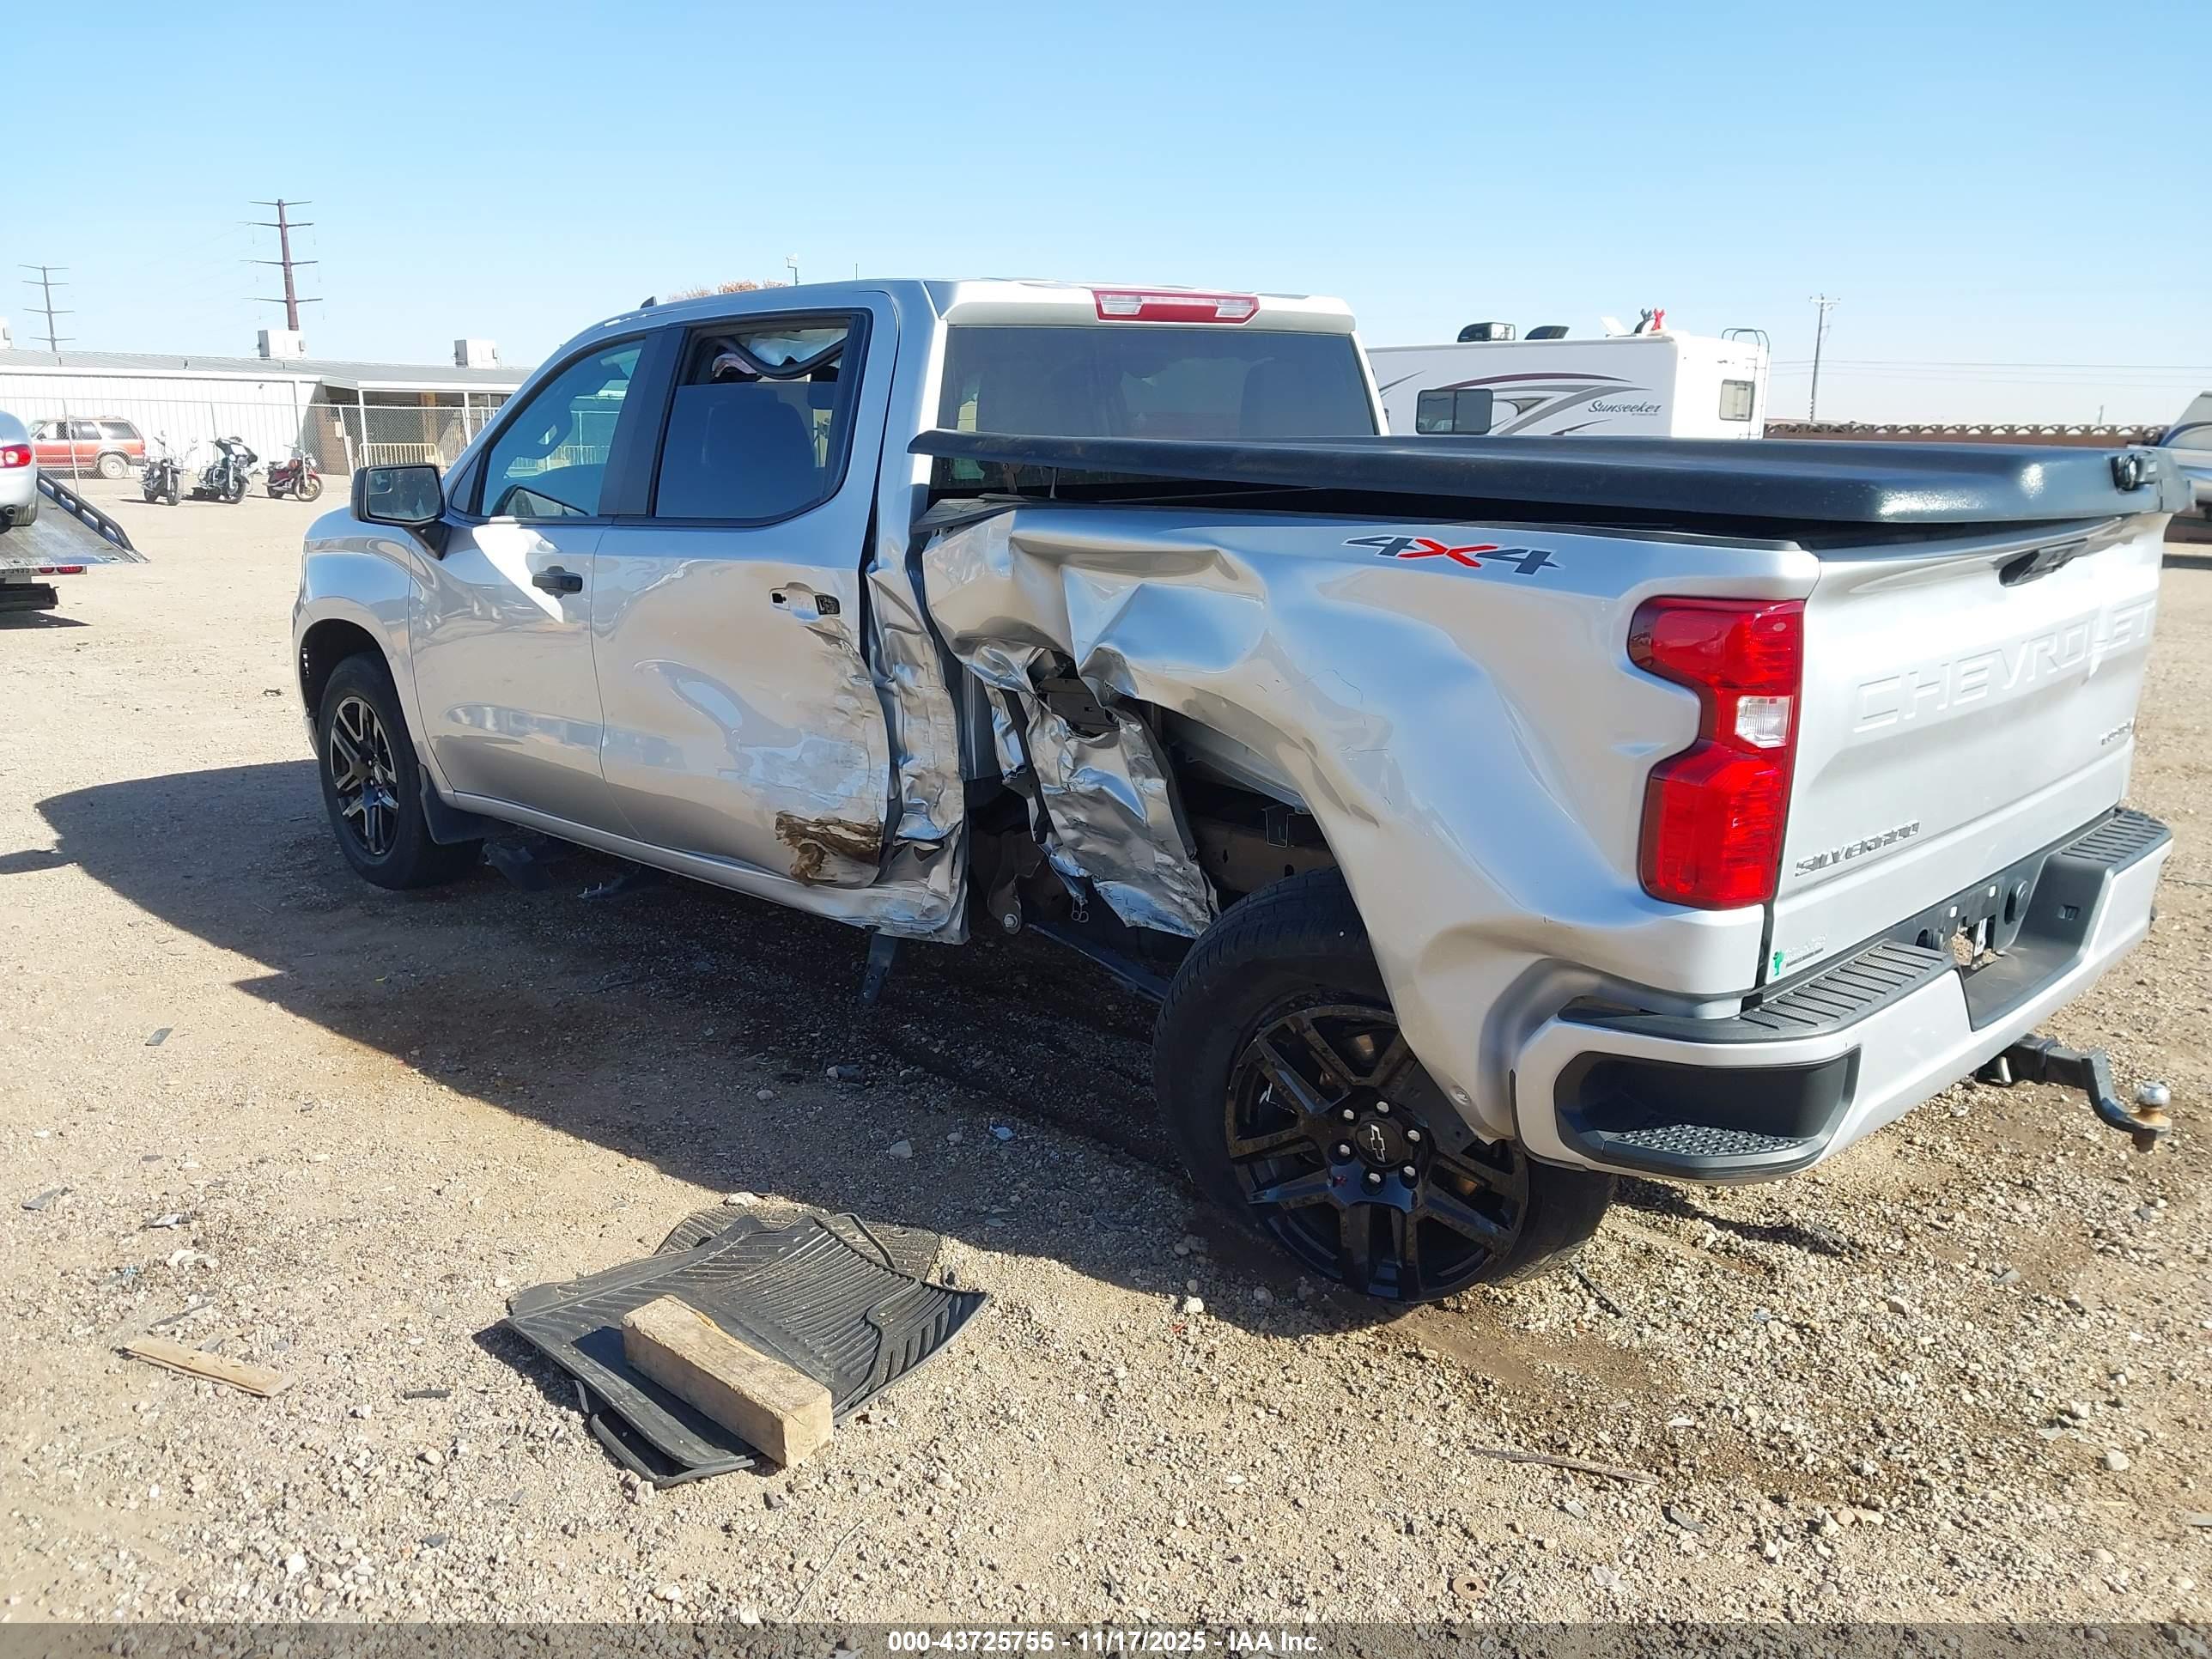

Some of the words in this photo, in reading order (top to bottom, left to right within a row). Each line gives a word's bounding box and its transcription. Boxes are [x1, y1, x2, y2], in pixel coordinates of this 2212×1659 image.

[1588, 399, 1662, 413] Sunseeker
[1344, 535, 1561, 575] 4X4
[1853, 599, 2156, 732] CHEVROLET
[1794, 820, 1920, 877] SILVERADO
